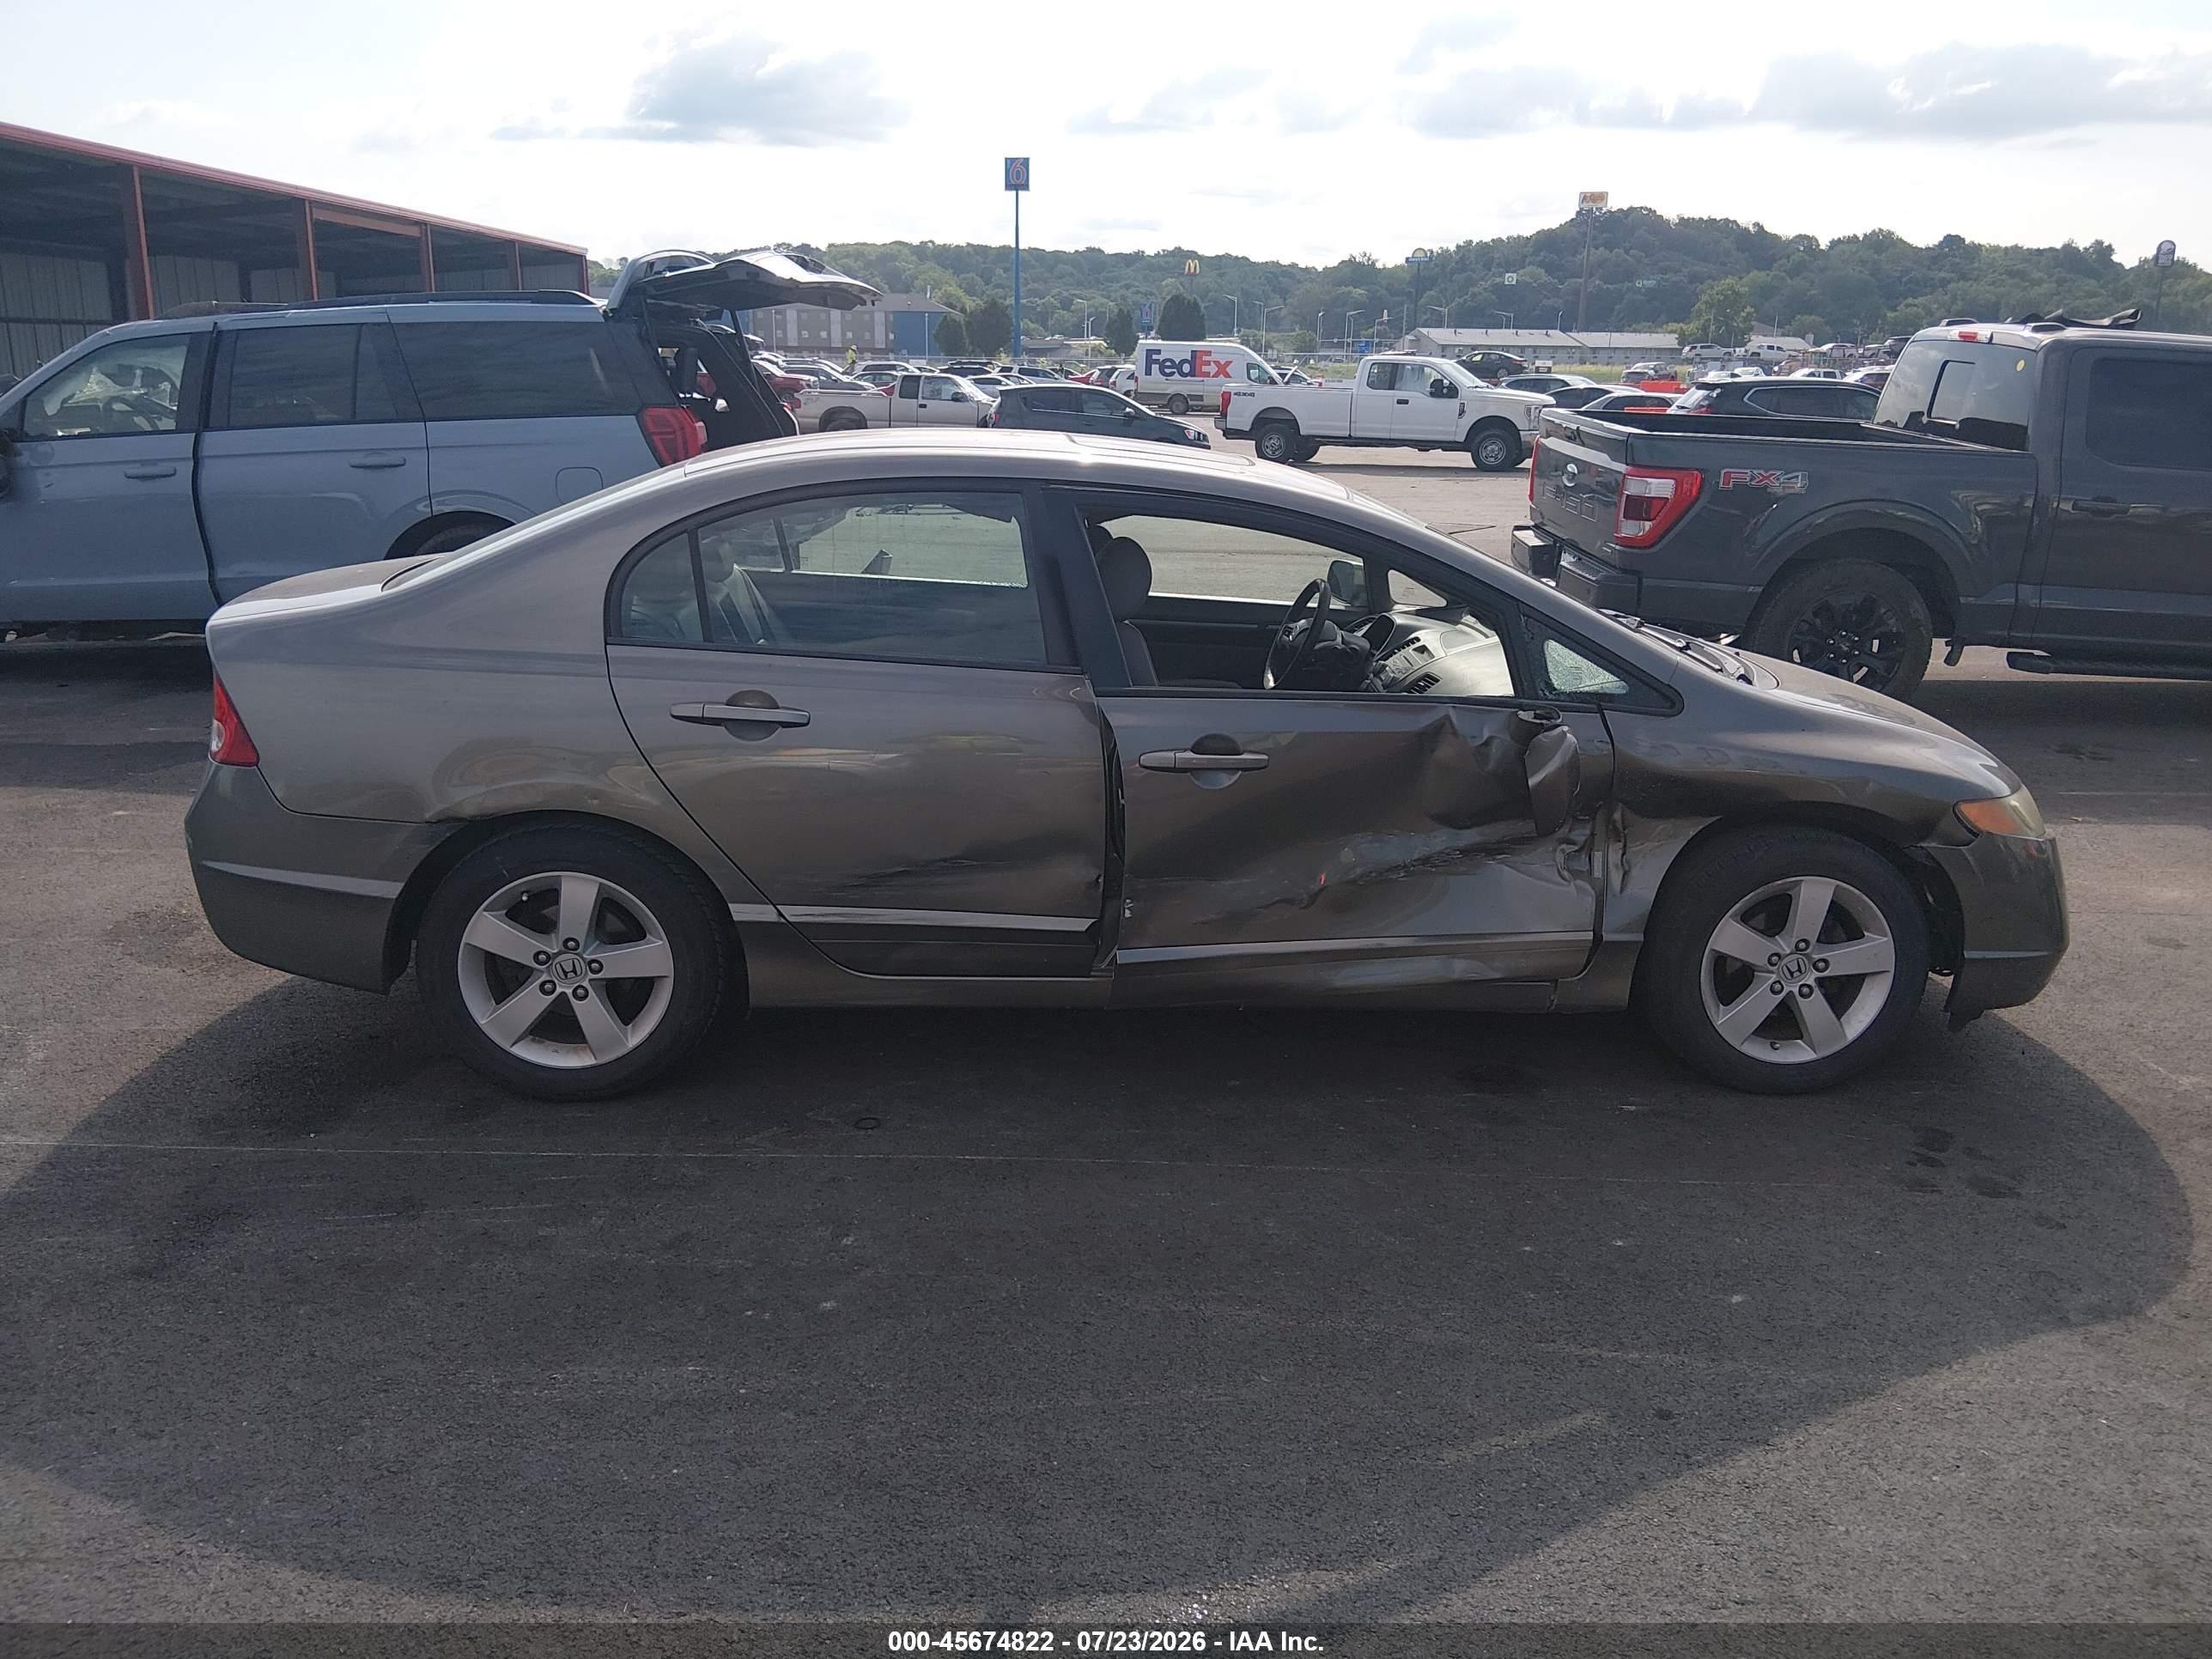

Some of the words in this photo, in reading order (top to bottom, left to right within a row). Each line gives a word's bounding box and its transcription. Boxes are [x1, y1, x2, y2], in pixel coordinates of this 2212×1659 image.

[1009, 158, 1027, 185] 6
[1145, 349, 1233, 378] FedEx
[1718, 468, 1808, 490] FX4
